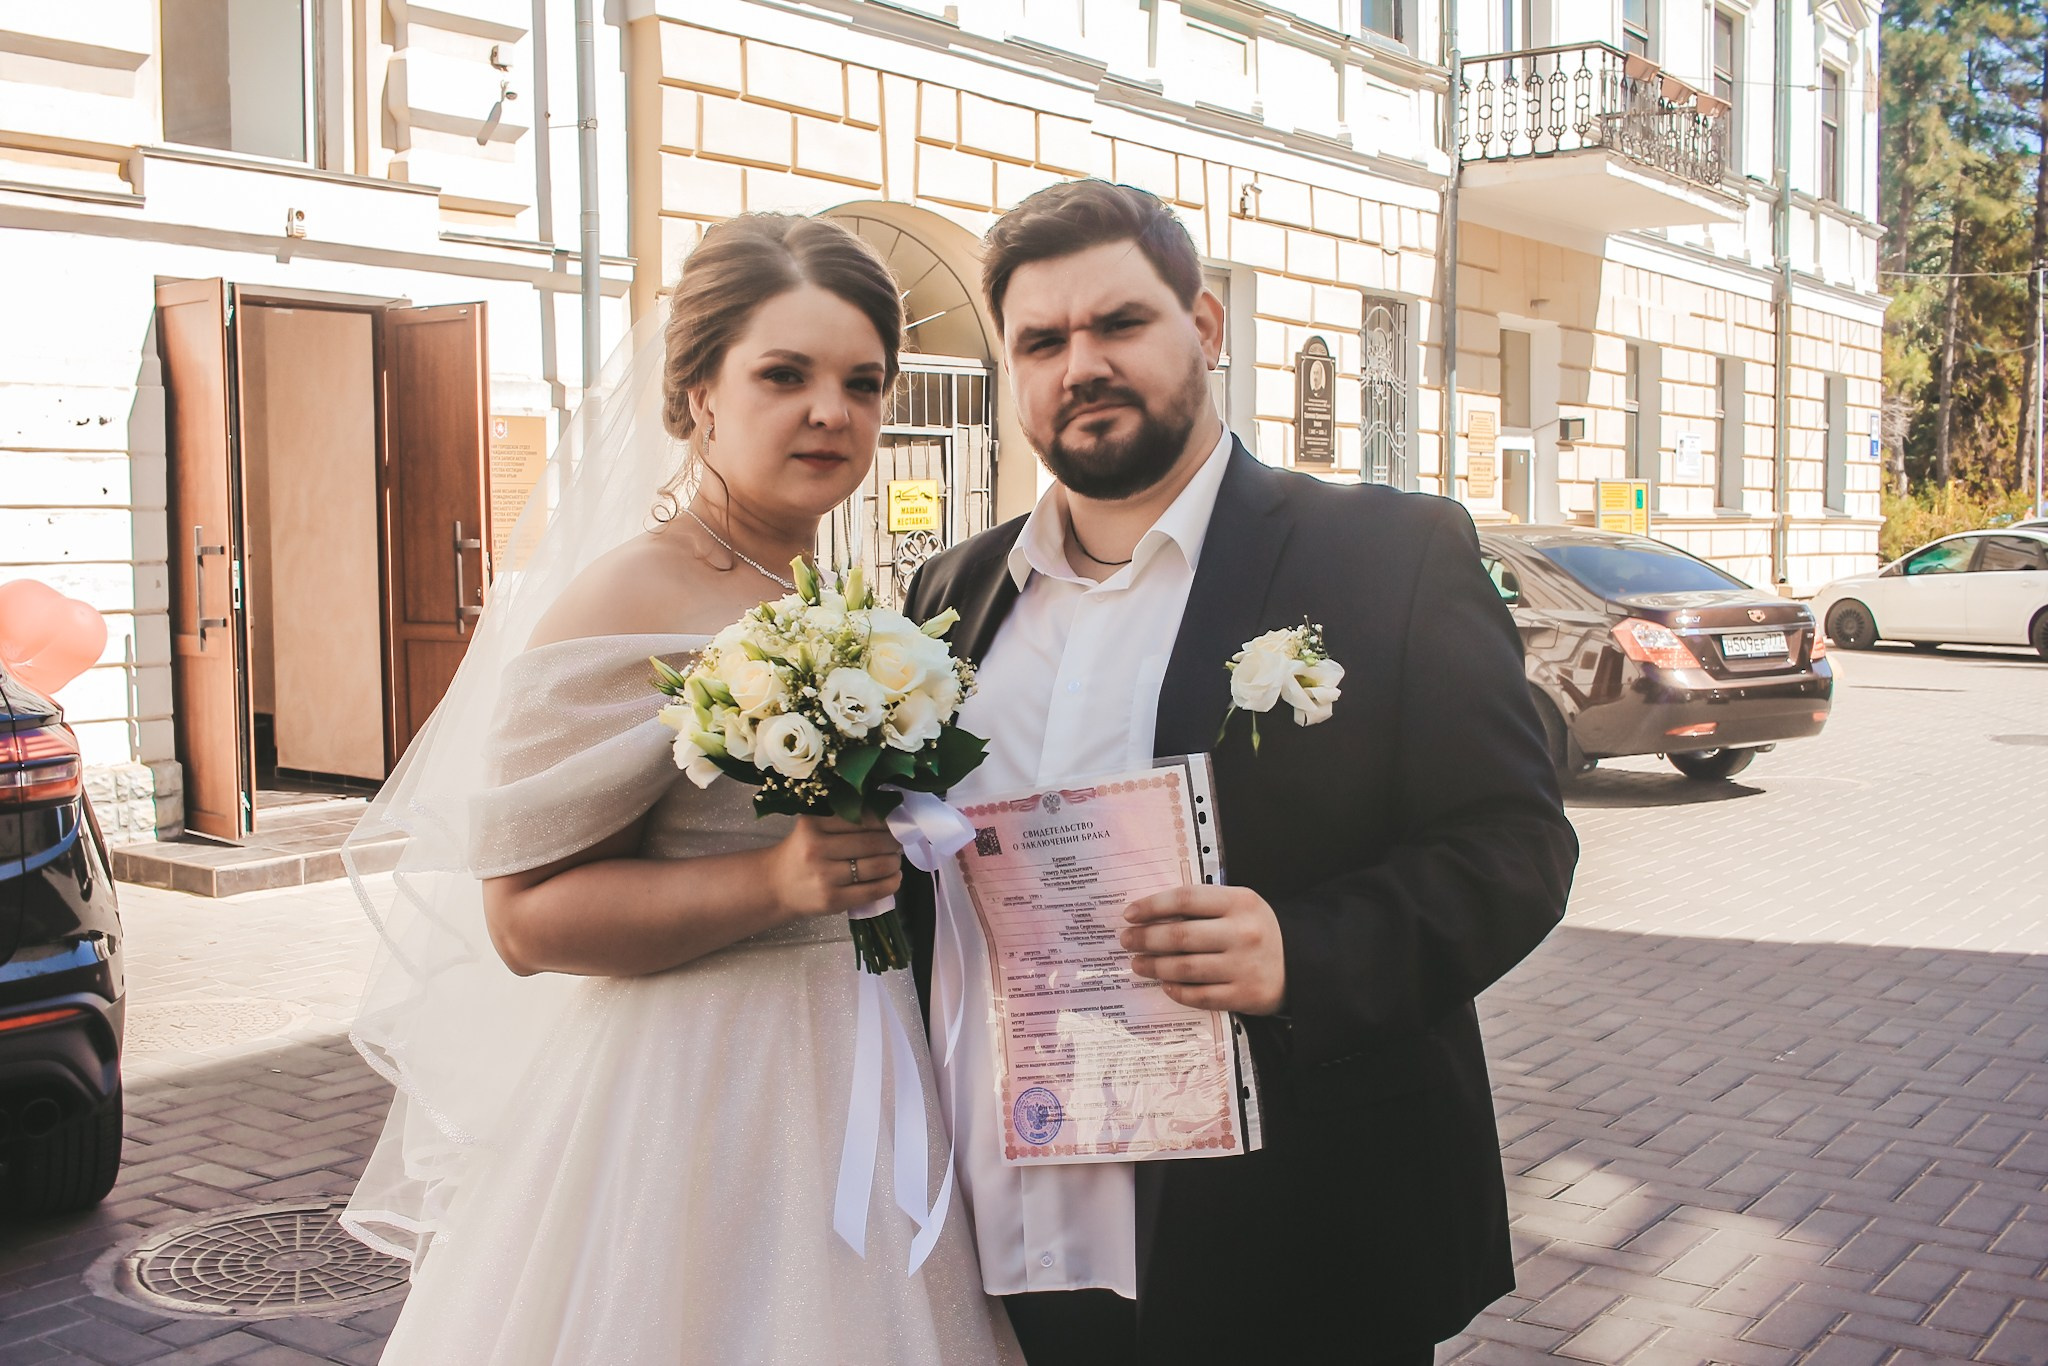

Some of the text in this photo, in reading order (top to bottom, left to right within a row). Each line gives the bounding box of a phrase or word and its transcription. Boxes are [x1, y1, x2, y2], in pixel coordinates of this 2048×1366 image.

[901, 506, 928, 514] МАШИНЫ
[1022, 821, 1094, 839] СВИДЕТЕЛЬСТВО
[1013, 830, 1110, 851] О ЗАКЛЮЧЕНИИ БРАКА
[1071, 878, 1097, 886] Федерация
